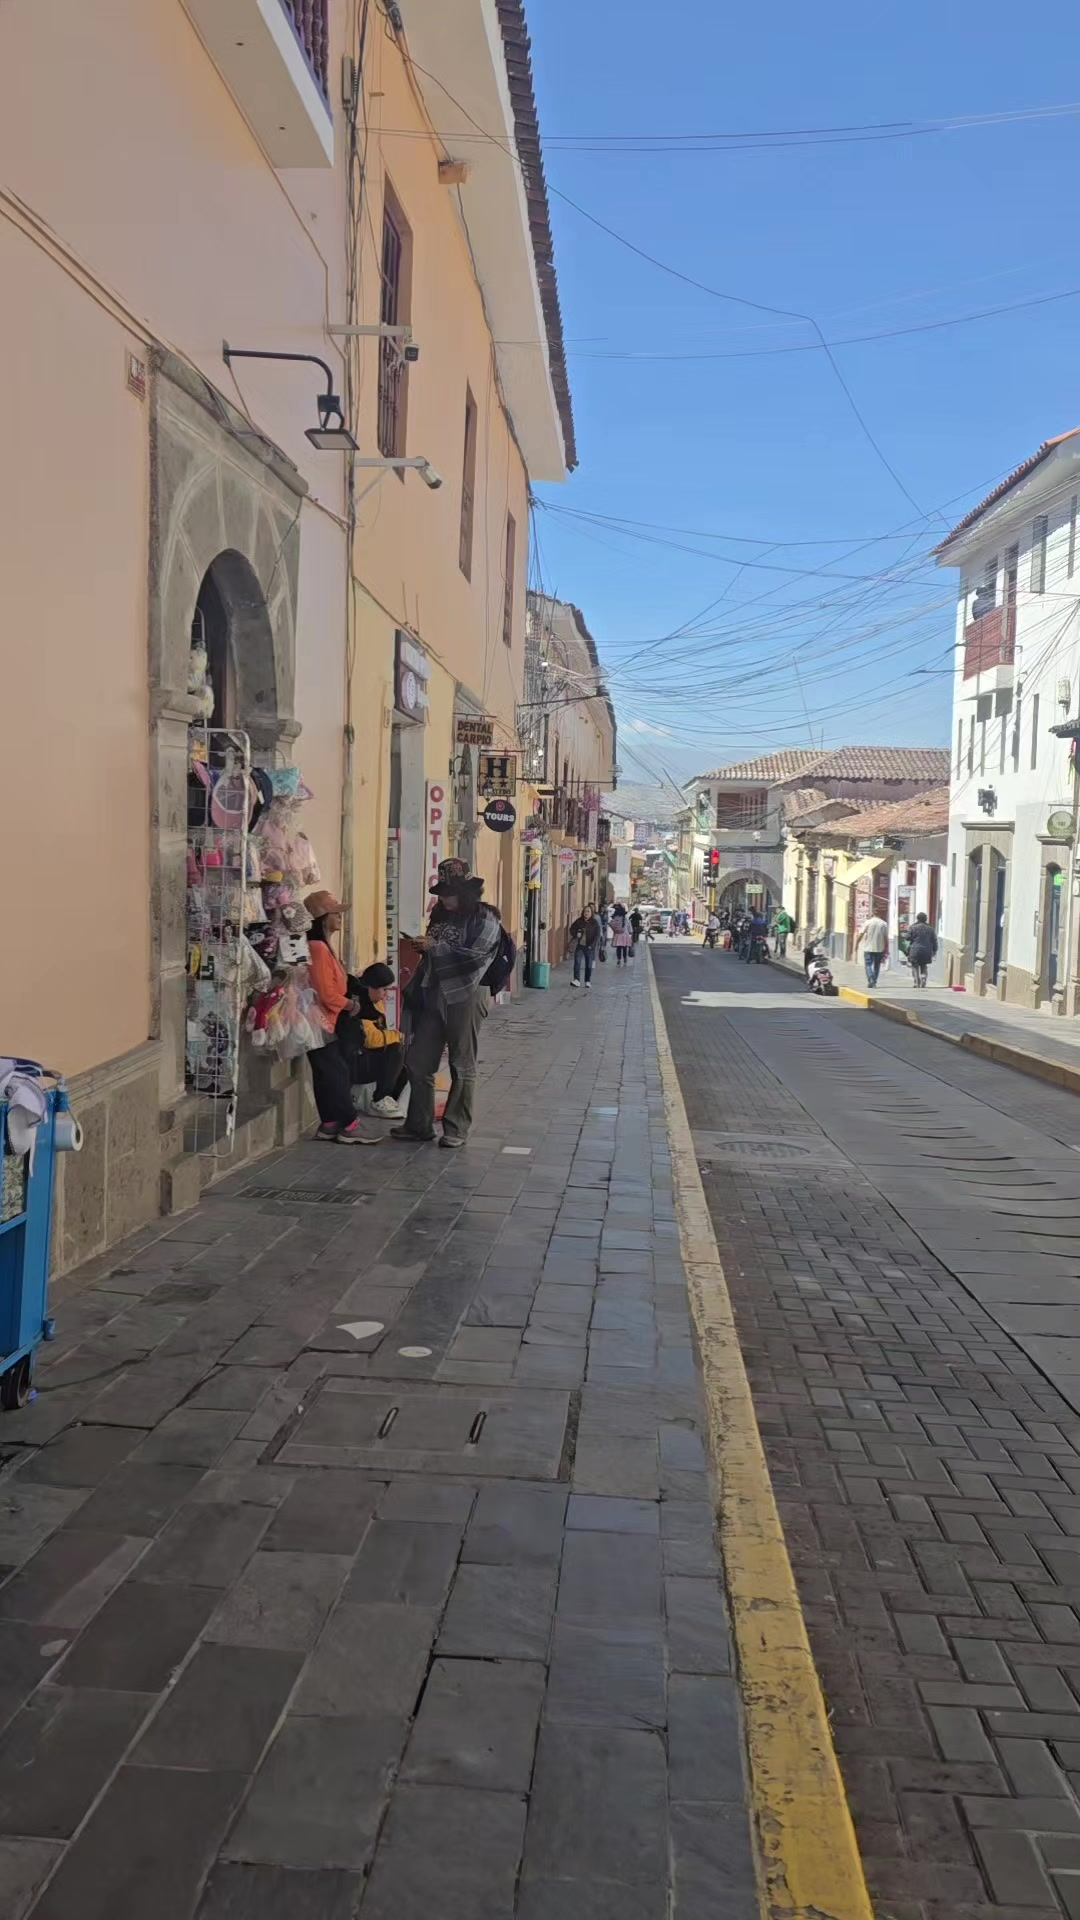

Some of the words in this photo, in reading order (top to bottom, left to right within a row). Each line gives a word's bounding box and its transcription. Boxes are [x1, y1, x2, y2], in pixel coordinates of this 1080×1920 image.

[457, 721, 493, 734] DENTAL
[457, 733, 492, 746] CARPIO
[486, 757, 510, 778] H
[485, 812, 515, 822] TOURS
